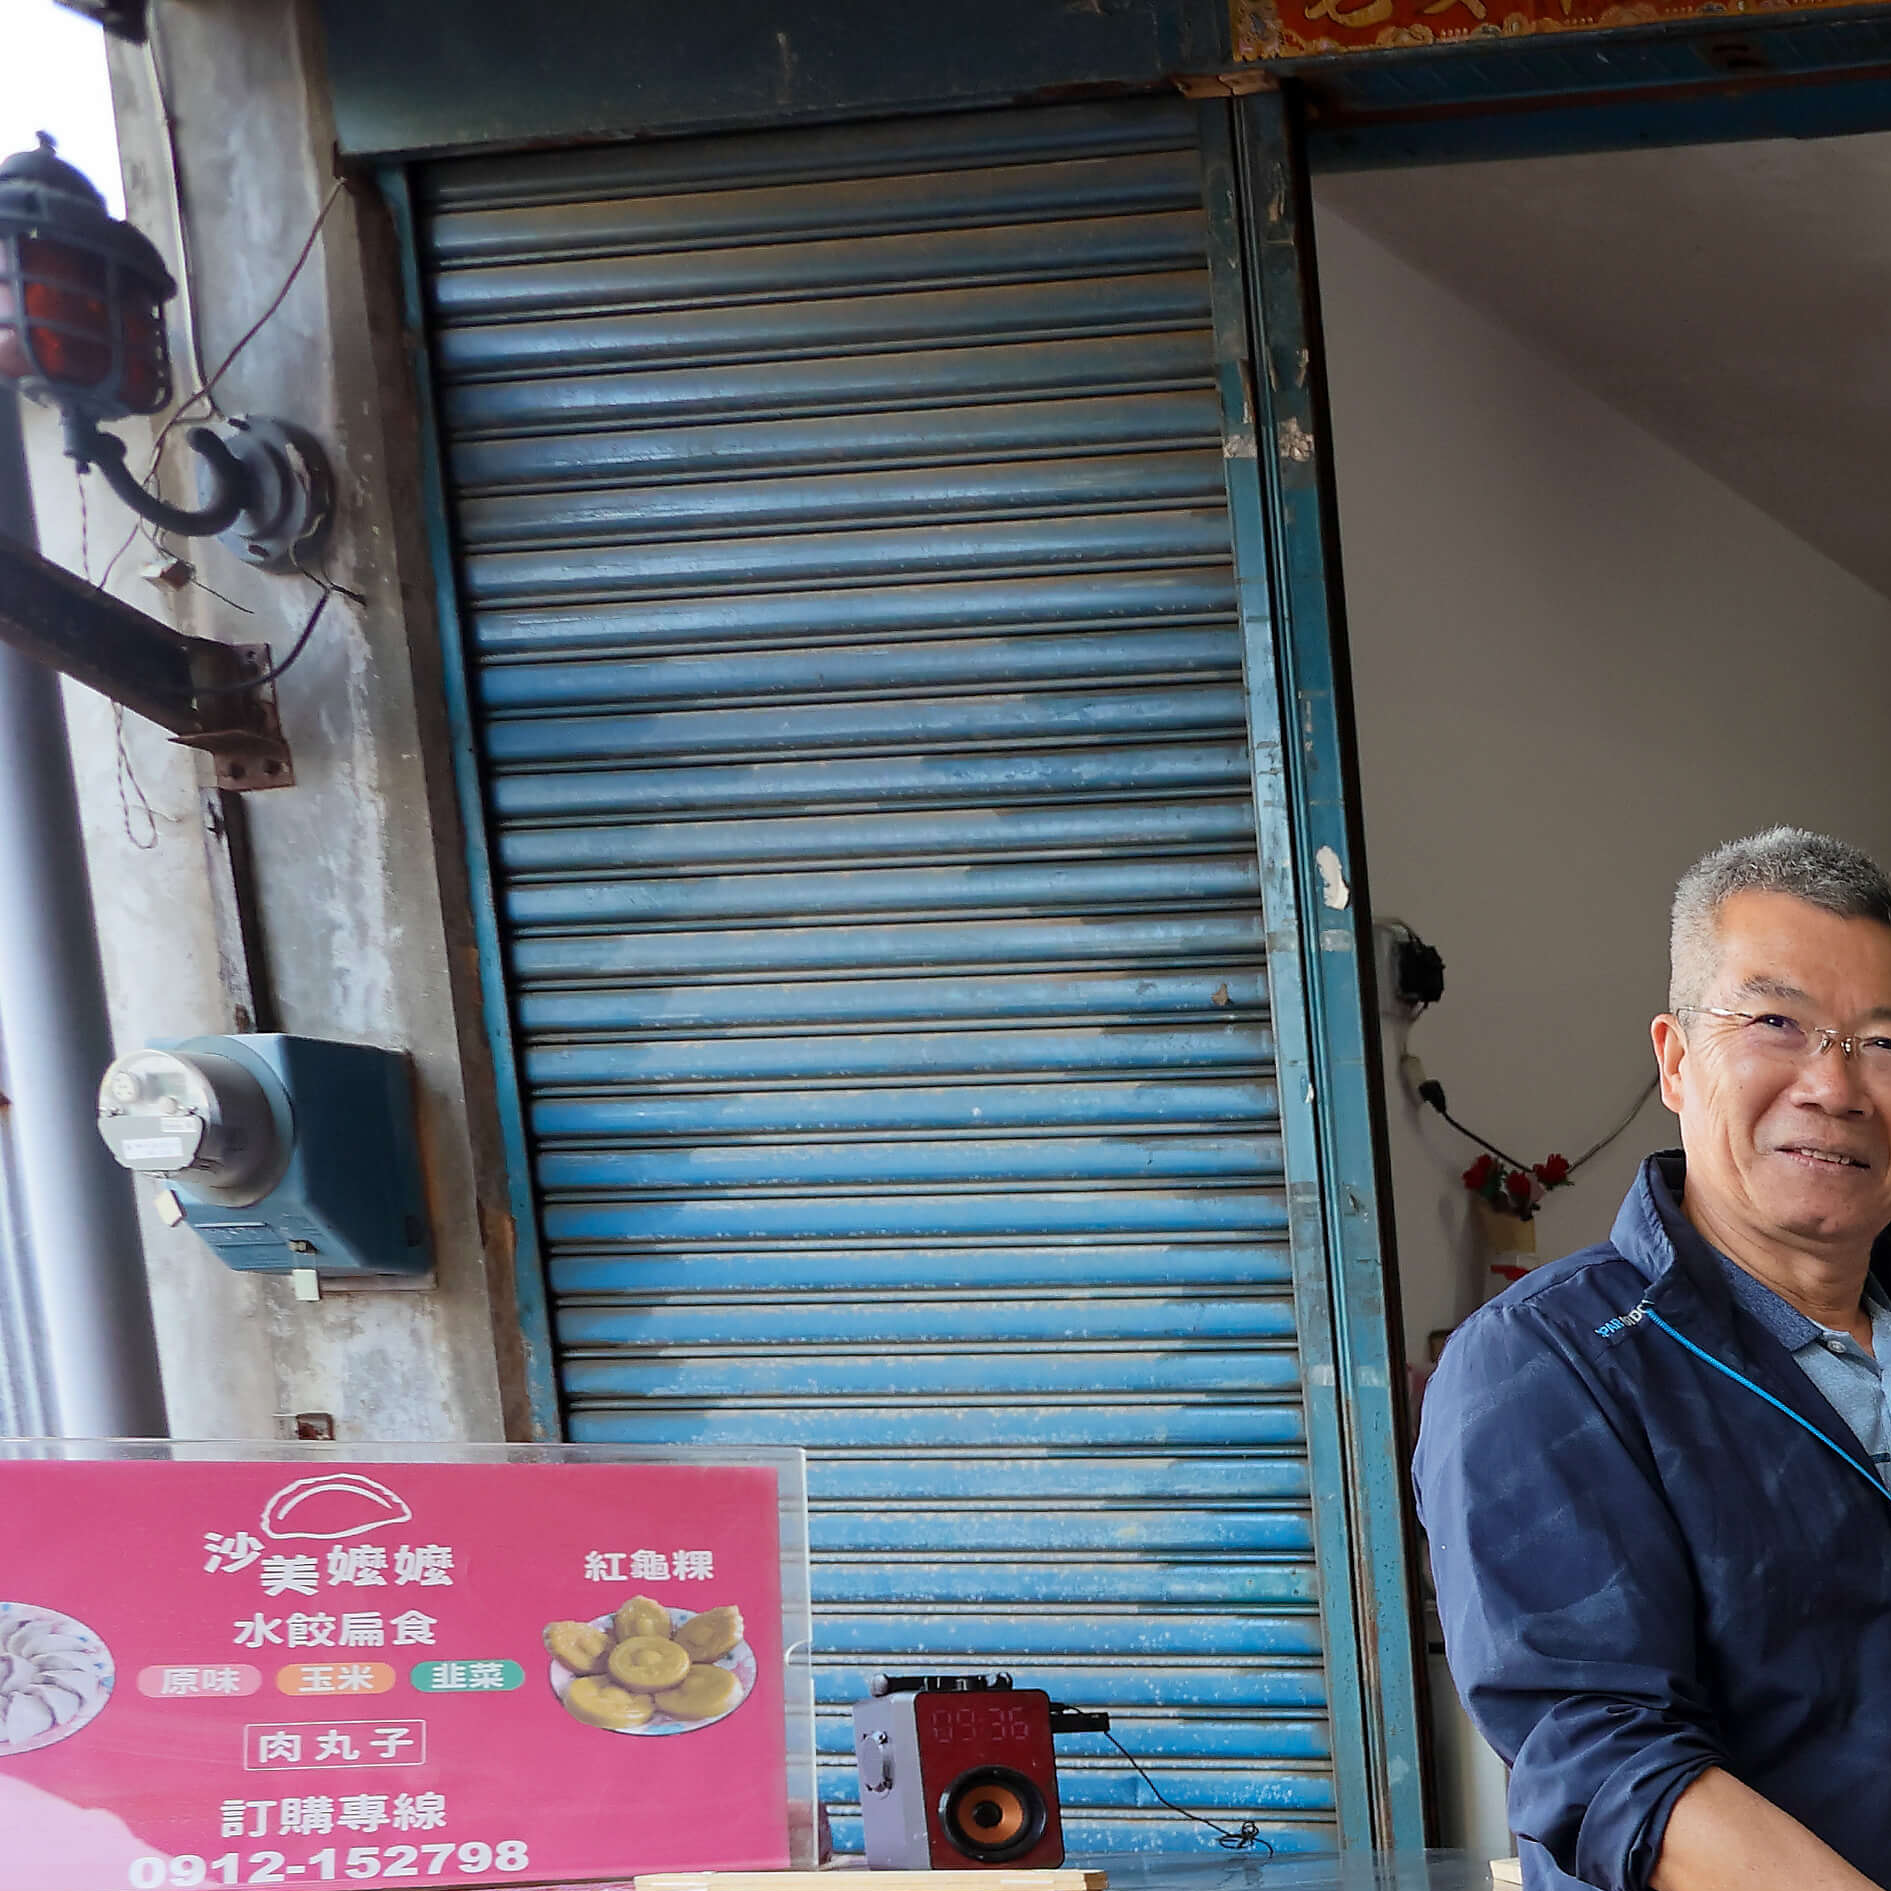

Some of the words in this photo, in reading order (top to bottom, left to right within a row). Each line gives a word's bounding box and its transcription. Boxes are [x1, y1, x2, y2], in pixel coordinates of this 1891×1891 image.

[203, 1531, 454, 1597] 沙美嬤嬤
[584, 1549, 714, 1582] 紅龜粿
[233, 1609, 438, 1649] 水餃扁食
[161, 1667, 241, 1696] 原味
[297, 1663, 375, 1693] 玉米
[431, 1662, 505, 1690] 韭菜
[258, 1726, 414, 1764] 肉丸子
[220, 1791, 447, 1839] 訂購專線
[128, 1839, 530, 1890] 0912-152798
